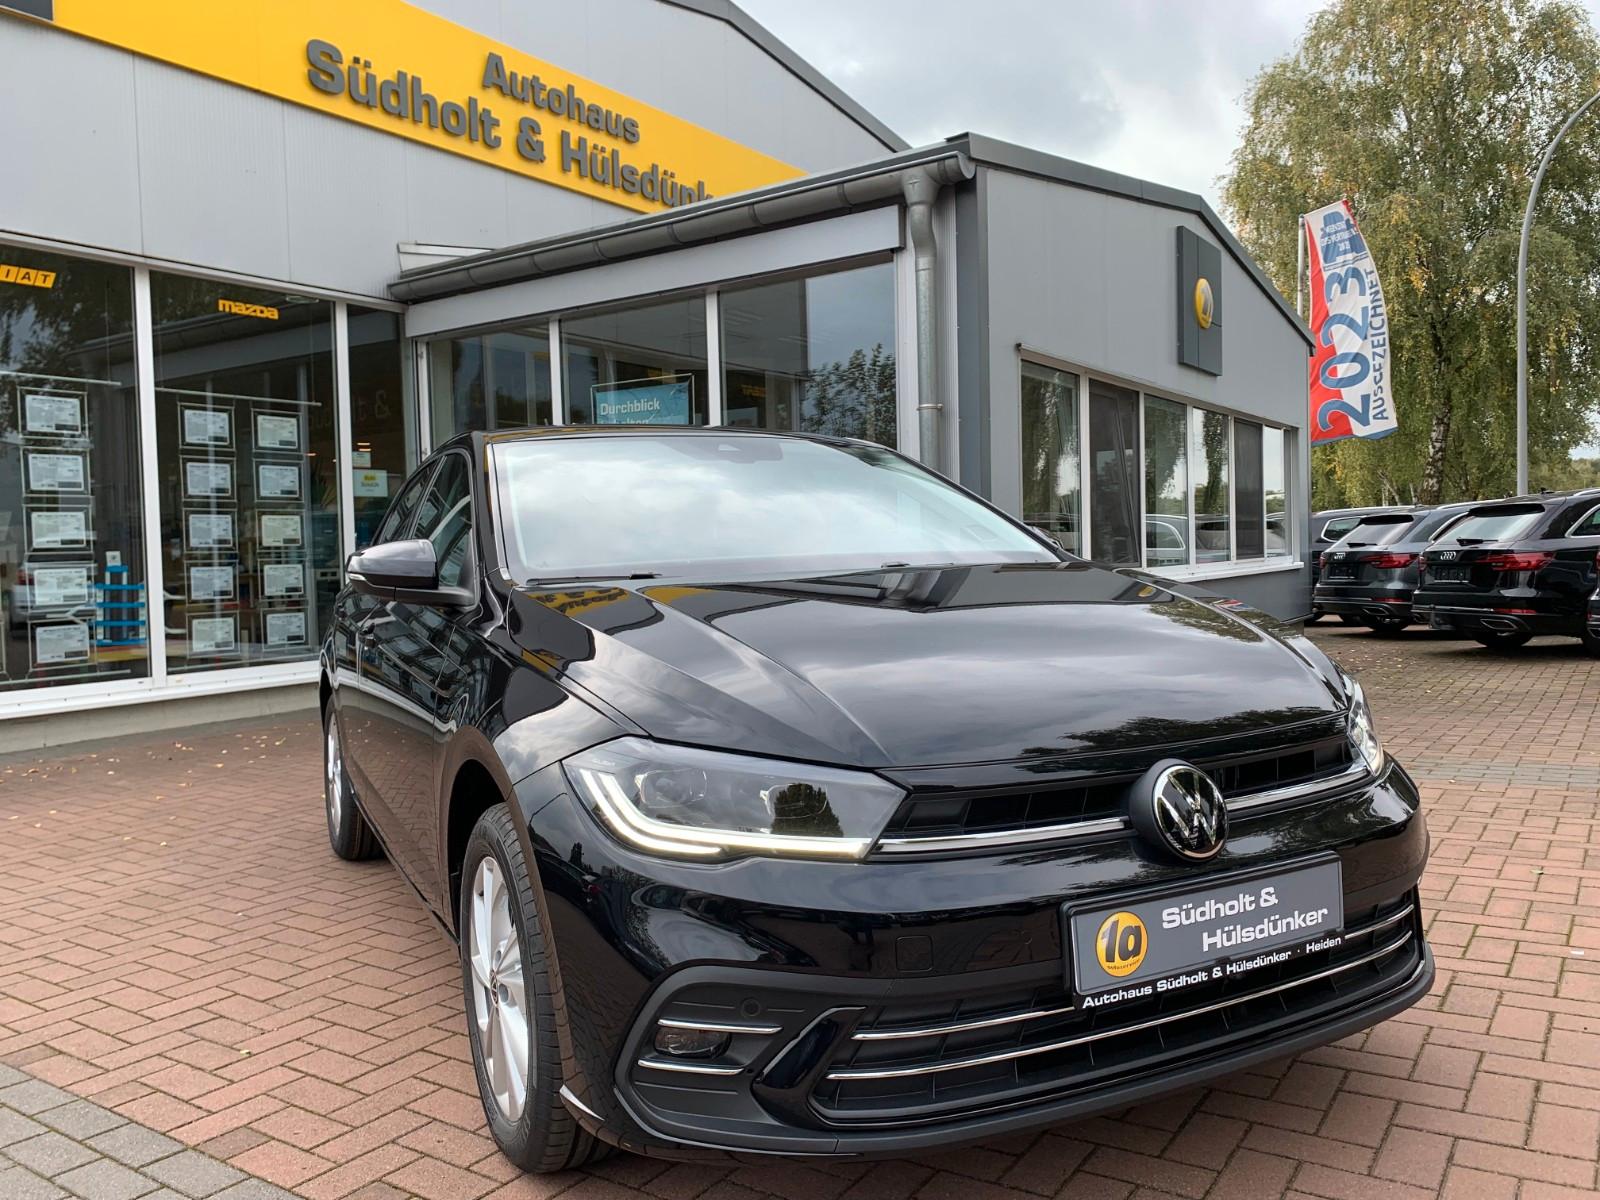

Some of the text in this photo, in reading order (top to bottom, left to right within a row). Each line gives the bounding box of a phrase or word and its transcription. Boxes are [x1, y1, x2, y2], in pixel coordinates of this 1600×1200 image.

[305, 38, 501, 149] Südholt
[516, 115, 546, 163] &
[482, 51, 641, 144] Autohaus
[218, 298, 279, 320] mazda
[1317, 266, 1371, 433] 2023
[600, 397, 660, 416] Durchblick
[1162, 886, 1279, 929] Südholt &
[1202, 907, 1328, 952] Hülsdünker
[1082, 936, 1341, 1009] Autohaus Südholt & Hülsdünker Heiden
